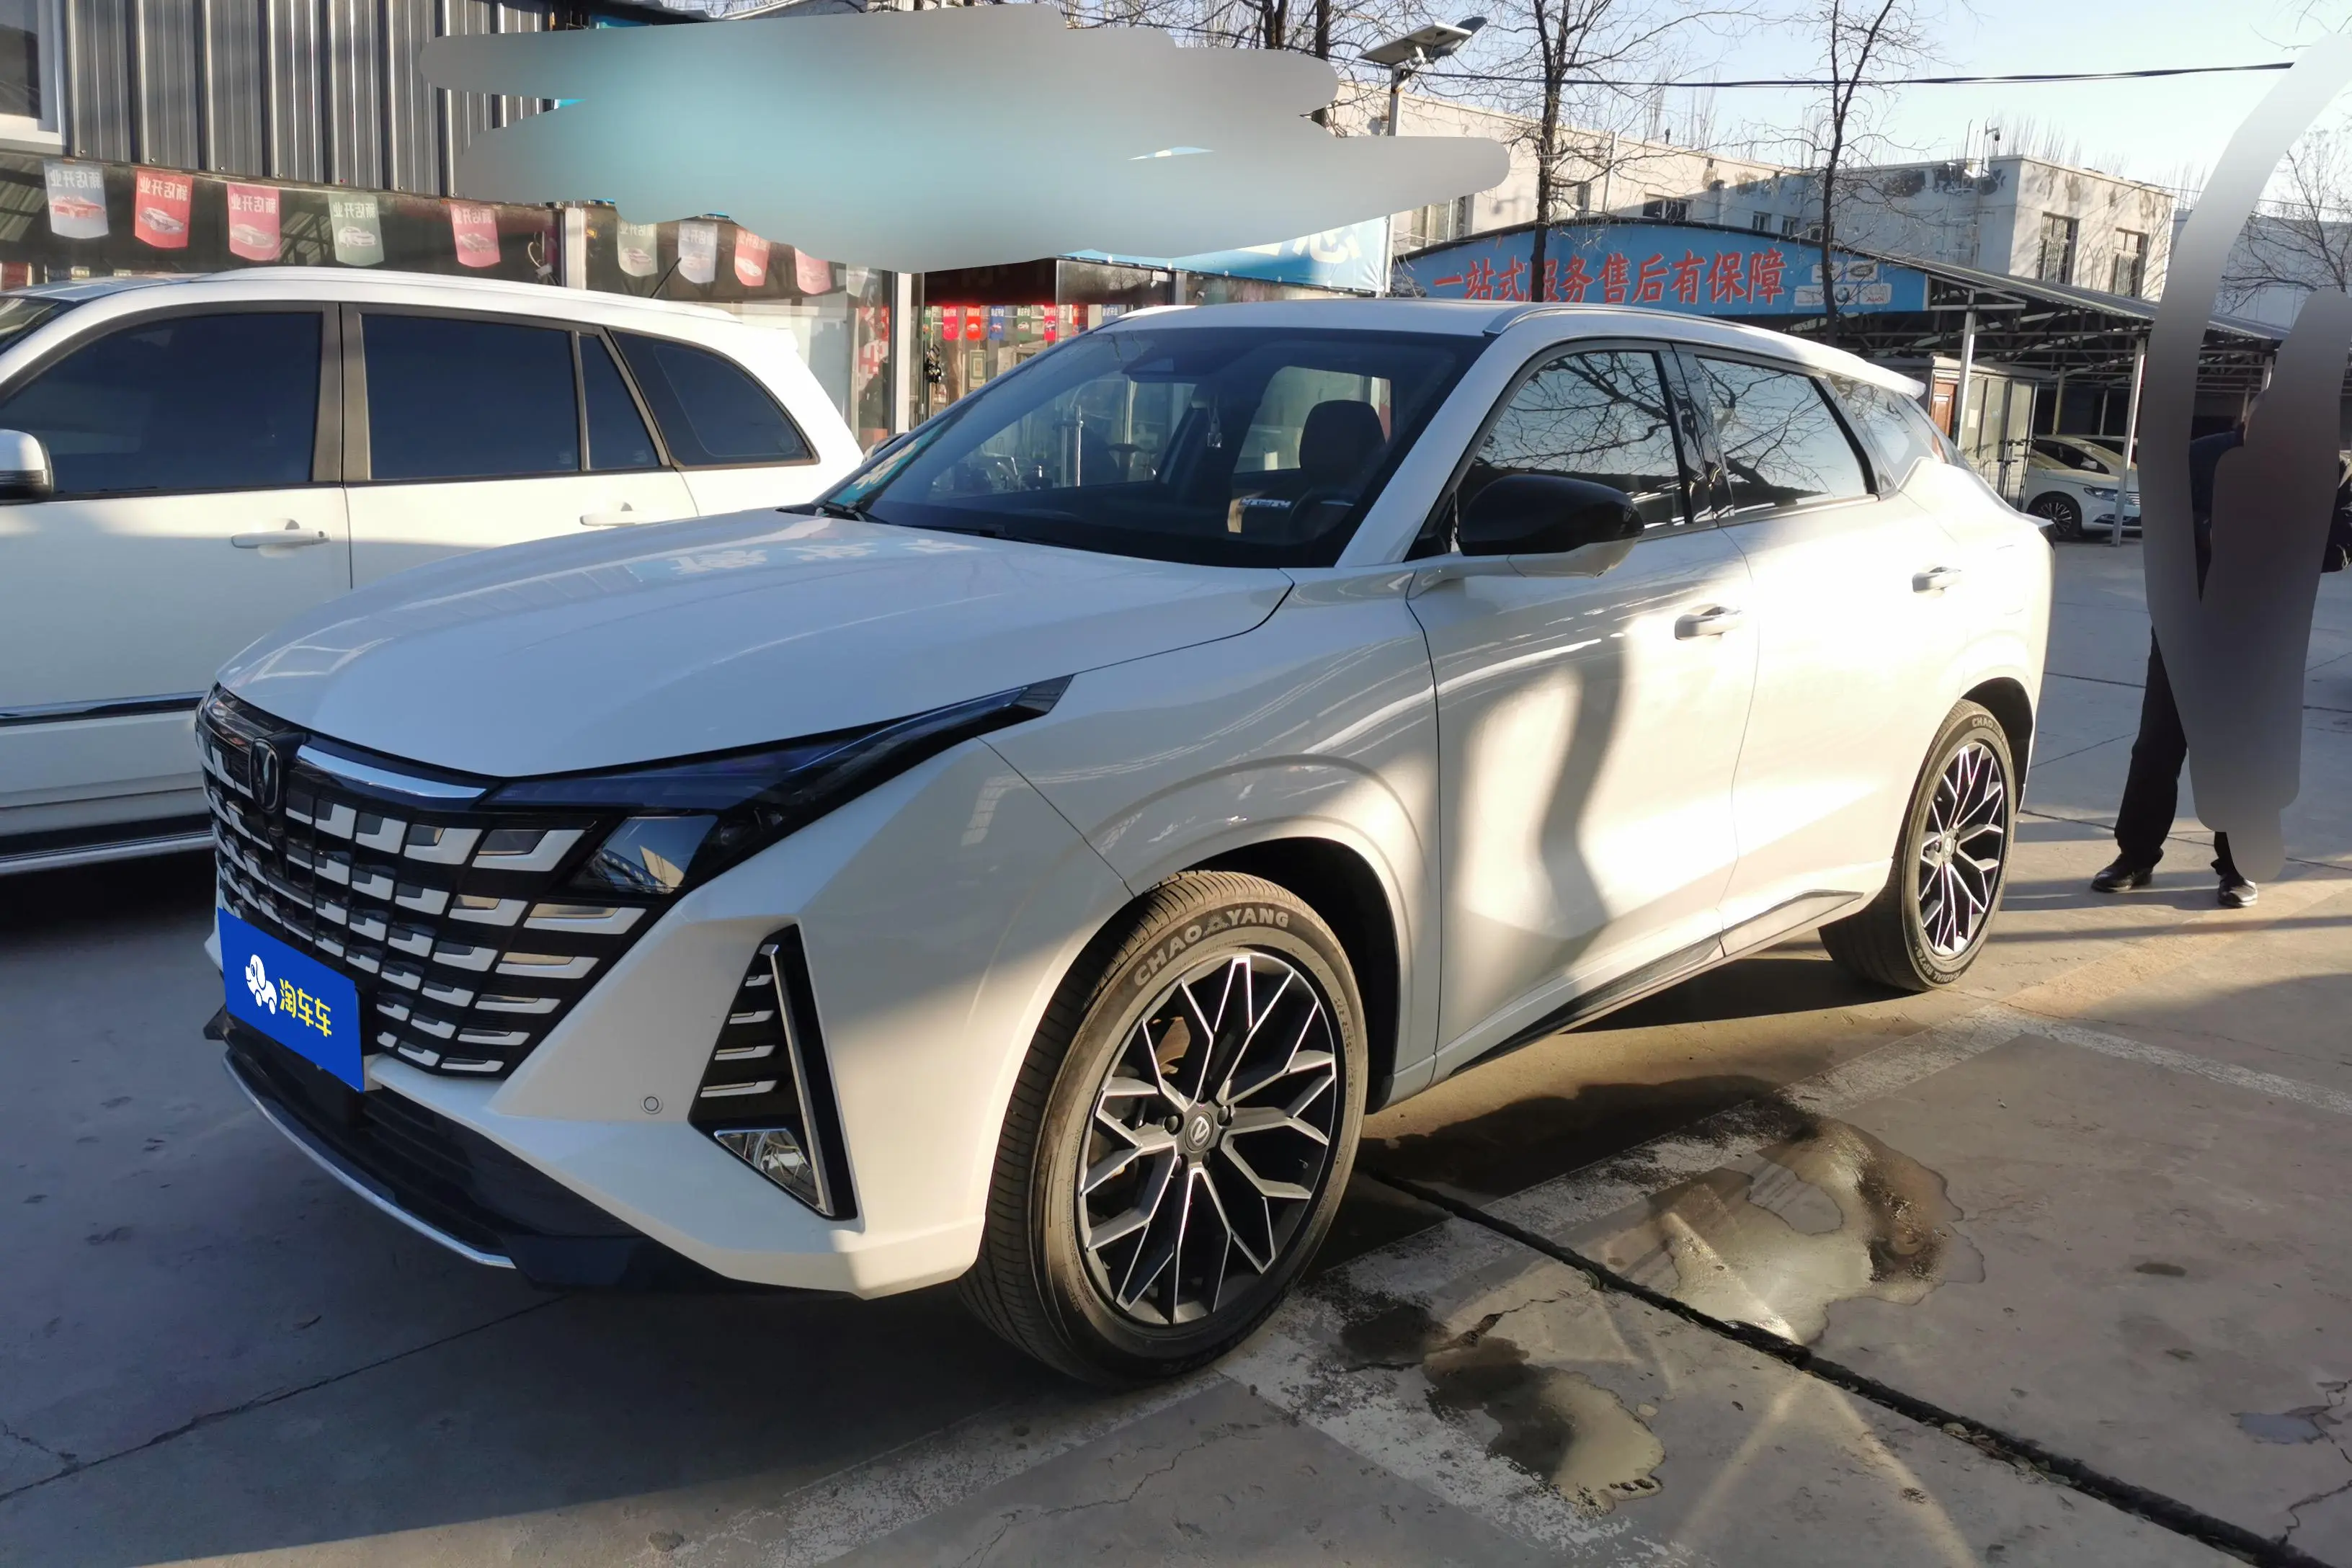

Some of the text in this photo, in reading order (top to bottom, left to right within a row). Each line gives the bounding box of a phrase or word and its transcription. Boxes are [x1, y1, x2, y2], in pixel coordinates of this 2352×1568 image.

[1433, 247, 1788, 306] 一站式服务售后有保障
[1133, 925, 1203, 986] CHAO
[1226, 907, 1289, 928] YANG
